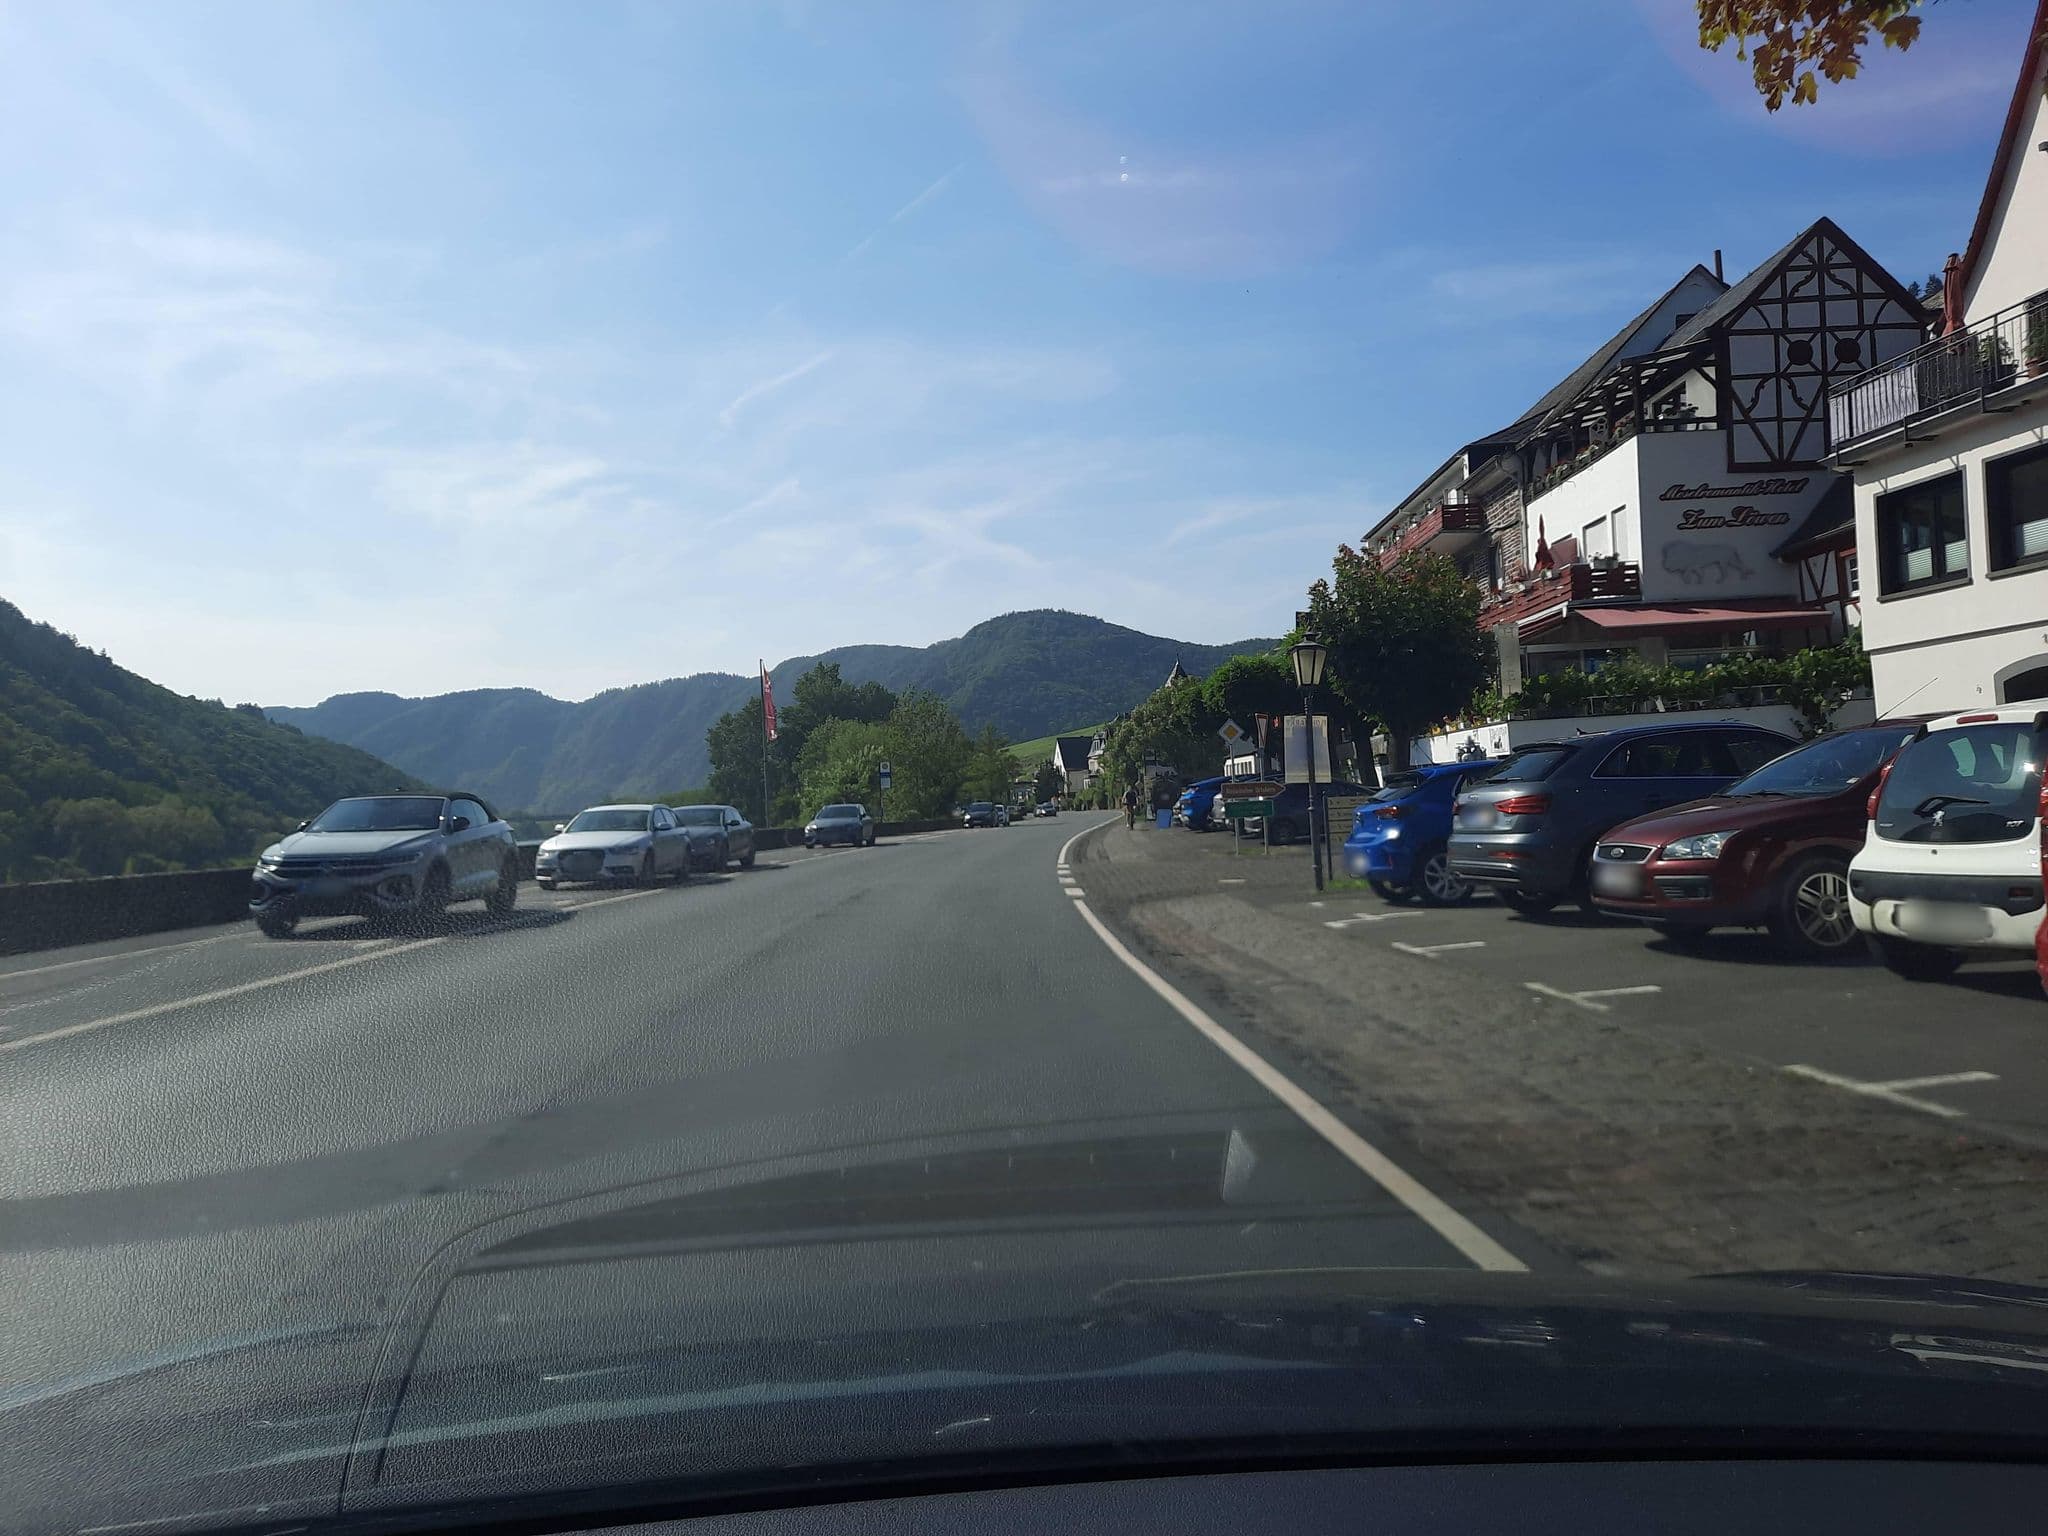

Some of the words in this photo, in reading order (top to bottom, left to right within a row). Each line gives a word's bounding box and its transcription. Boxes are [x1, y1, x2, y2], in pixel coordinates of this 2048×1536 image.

[1659, 478, 1809, 501] Moselromantik-Hotel
[1677, 509, 1726, 530] Zum
[1725, 506, 1790, 527] Löwen
